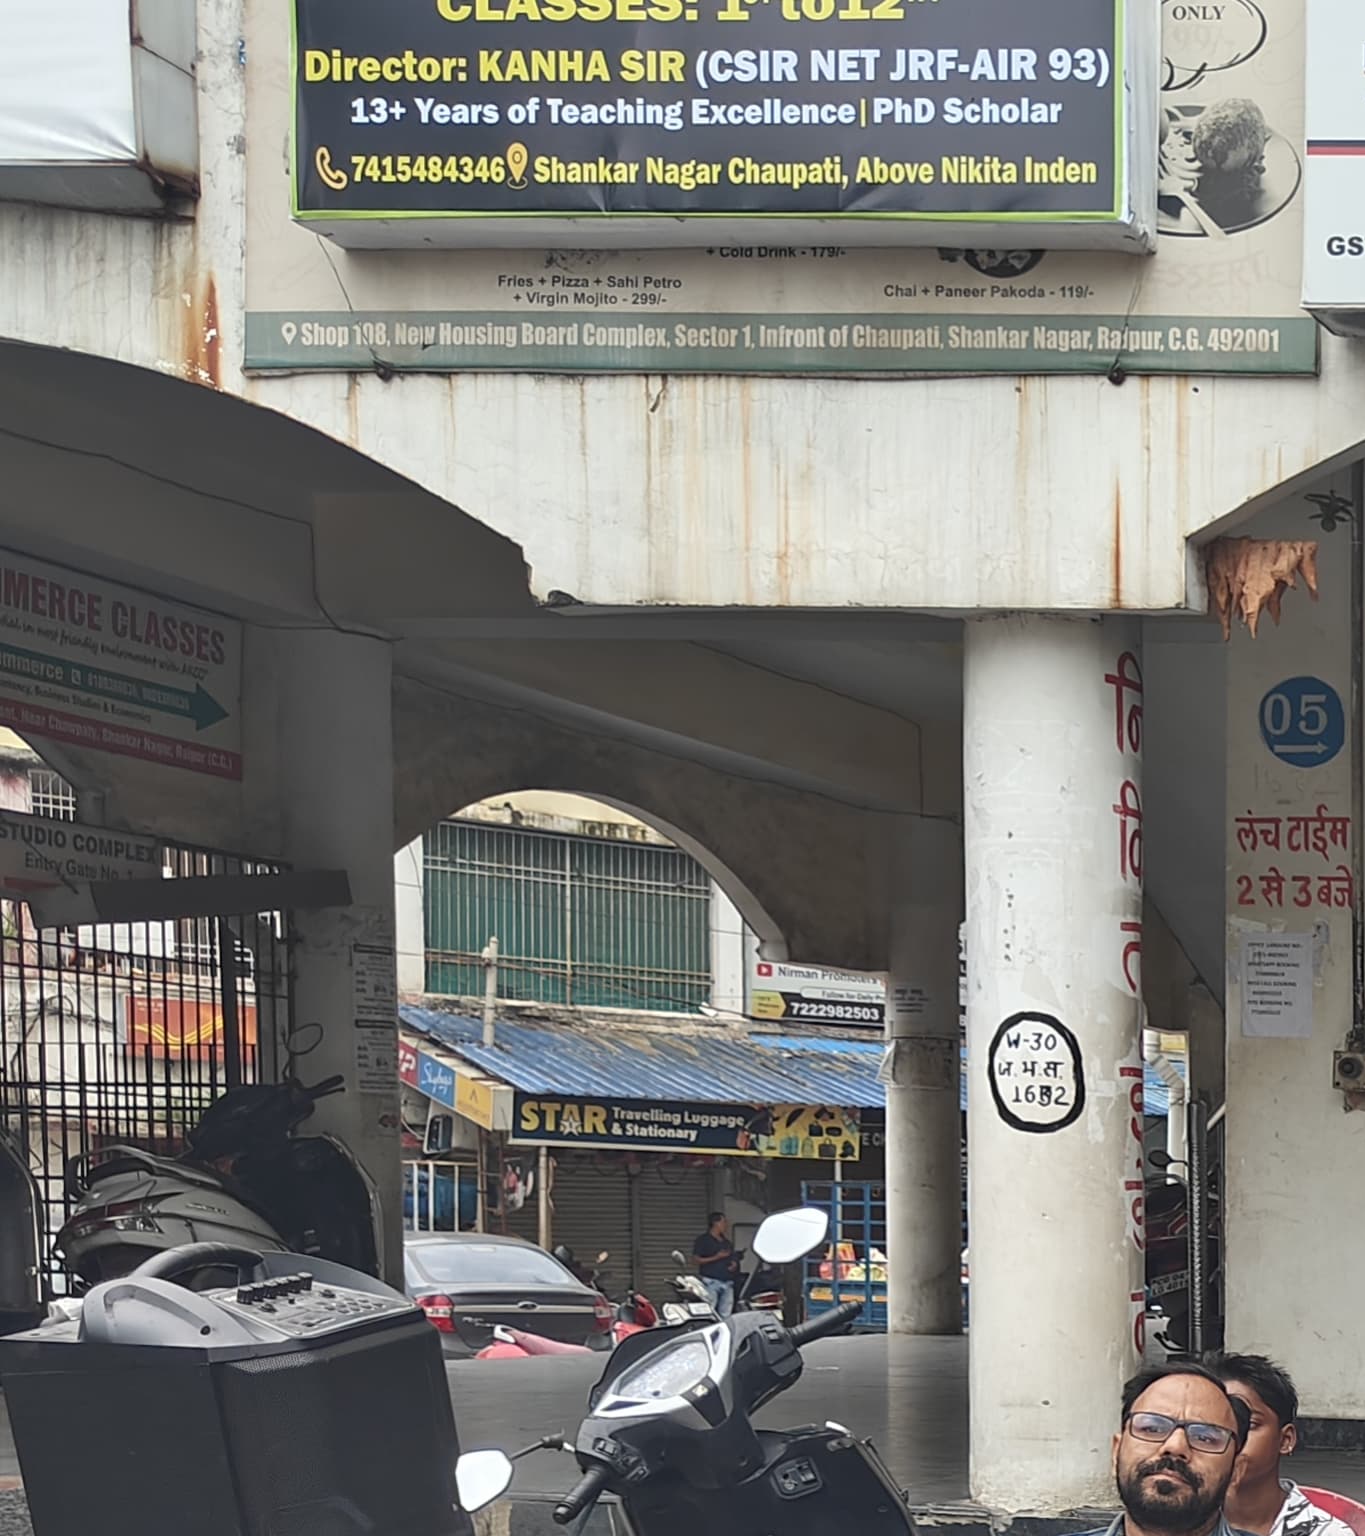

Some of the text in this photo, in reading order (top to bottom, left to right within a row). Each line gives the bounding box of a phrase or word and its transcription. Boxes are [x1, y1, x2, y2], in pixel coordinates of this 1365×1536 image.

[1172, 6, 1226, 20] ONLY
[305, 48, 1110, 88] Director: KANHA SIR (CSIR NET JRF-AIR 93)
[350, 98, 406, 124] 13+
[415, 98, 499, 124] Years
[507, 98, 540, 124] of
[547, 98, 683, 130] Teaching
[873, 98, 936, 124] PhD
[943, 98, 1062, 124] Scholar
[351, 156, 1096, 189] 7415484346 Shankar Nagar Chaupati, Above Nikita Inden
[720, 246, 752, 257] Cold
[757, 246, 796, 257] Drink
[498, 275, 535, 288] Fries
[552, 275, 590, 288] Pizza
[607, 275, 638, 288] Sahi
[643, 276, 682, 289] Petro
[884, 285, 917, 298] Chai
[935, 285, 986, 298] Paneer
[990, 286, 1045, 298] Pakoda
[1061, 286, 1094, 298] 119/-
[526, 292, 569, 306] Virgin
[573, 292, 617, 306] Mojito
[632, 293, 667, 305] 299/-
[301, 323, 349, 347] Shop
[395, 323, 436, 346] New
[439, 323, 515, 348] Housing
[522, 323, 578, 346] Board
[583, 323, 671, 349] Complex,
[674, 324, 738, 348] Sector
[759, 325, 825, 349] Infront
[829, 325, 850, 348] of
[852, 325, 945, 351] Chaupati,
[949, 325, 1029, 349] Shankar
[1034, 327, 1093, 352] Nagar,
[1097, 327, 1164, 353] Raipur,
[1168, 328, 1203, 351] C.G.
[1207, 328, 1280, 352] 492001
[0, 568, 225, 665] MERCE CLASSES
[1263, 693, 1328, 736] 05
[0, 819, 156, 864] STUDIO COMPLEX
[1235, 810, 1281, 852] लंच
[25, 851, 63, 873] Entry
[66, 858, 98, 878] Gate
[1236, 865, 1354, 908] 2 से 3 बजे
[778, 966, 818, 979] Nirman
[790, 1002, 879, 1021] 7222982503
[1006, 1032, 1057, 1050] W-30
[520, 1101, 608, 1136] STAR
[612, 1107, 745, 1128] Travelling Luggage
[612, 1122, 697, 1141] & Stationary
